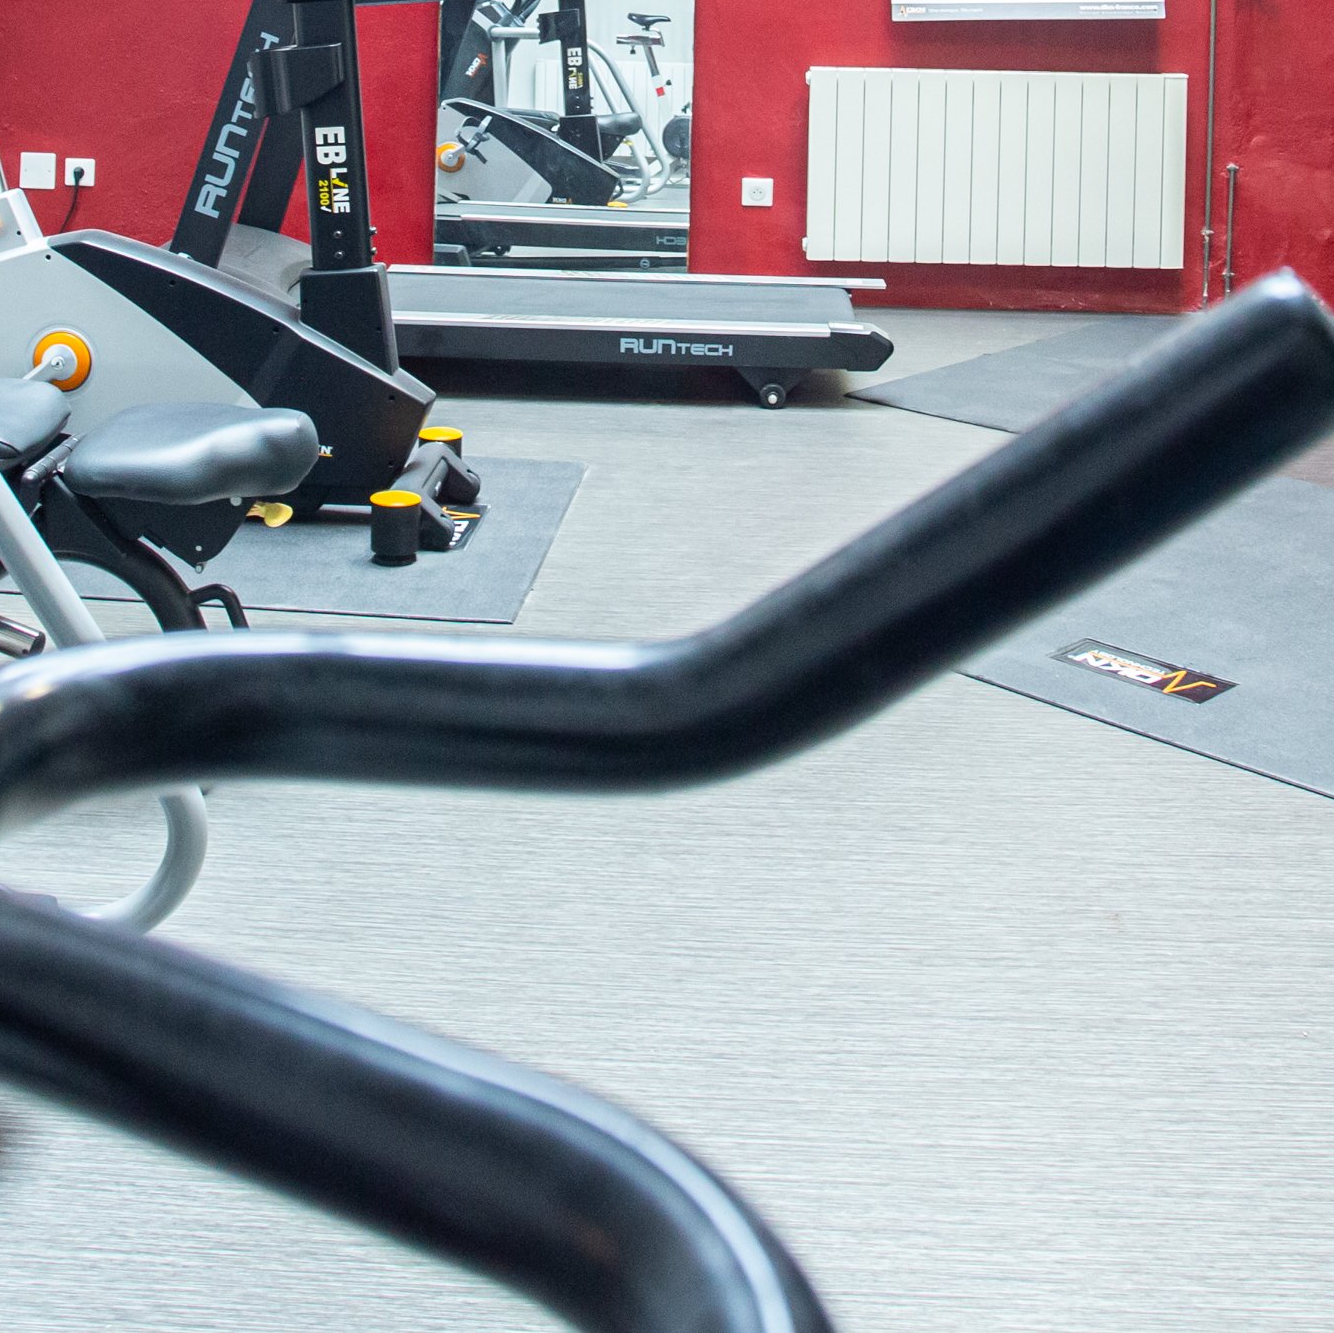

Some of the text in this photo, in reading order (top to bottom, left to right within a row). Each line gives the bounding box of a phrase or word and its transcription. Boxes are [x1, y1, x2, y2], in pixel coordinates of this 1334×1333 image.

[194, 31, 279, 219] RUNTEH
[318, 179, 330, 206] 2100
[619, 337, 734, 357] RUNTECH
[1073, 652, 1163, 685] DKN
